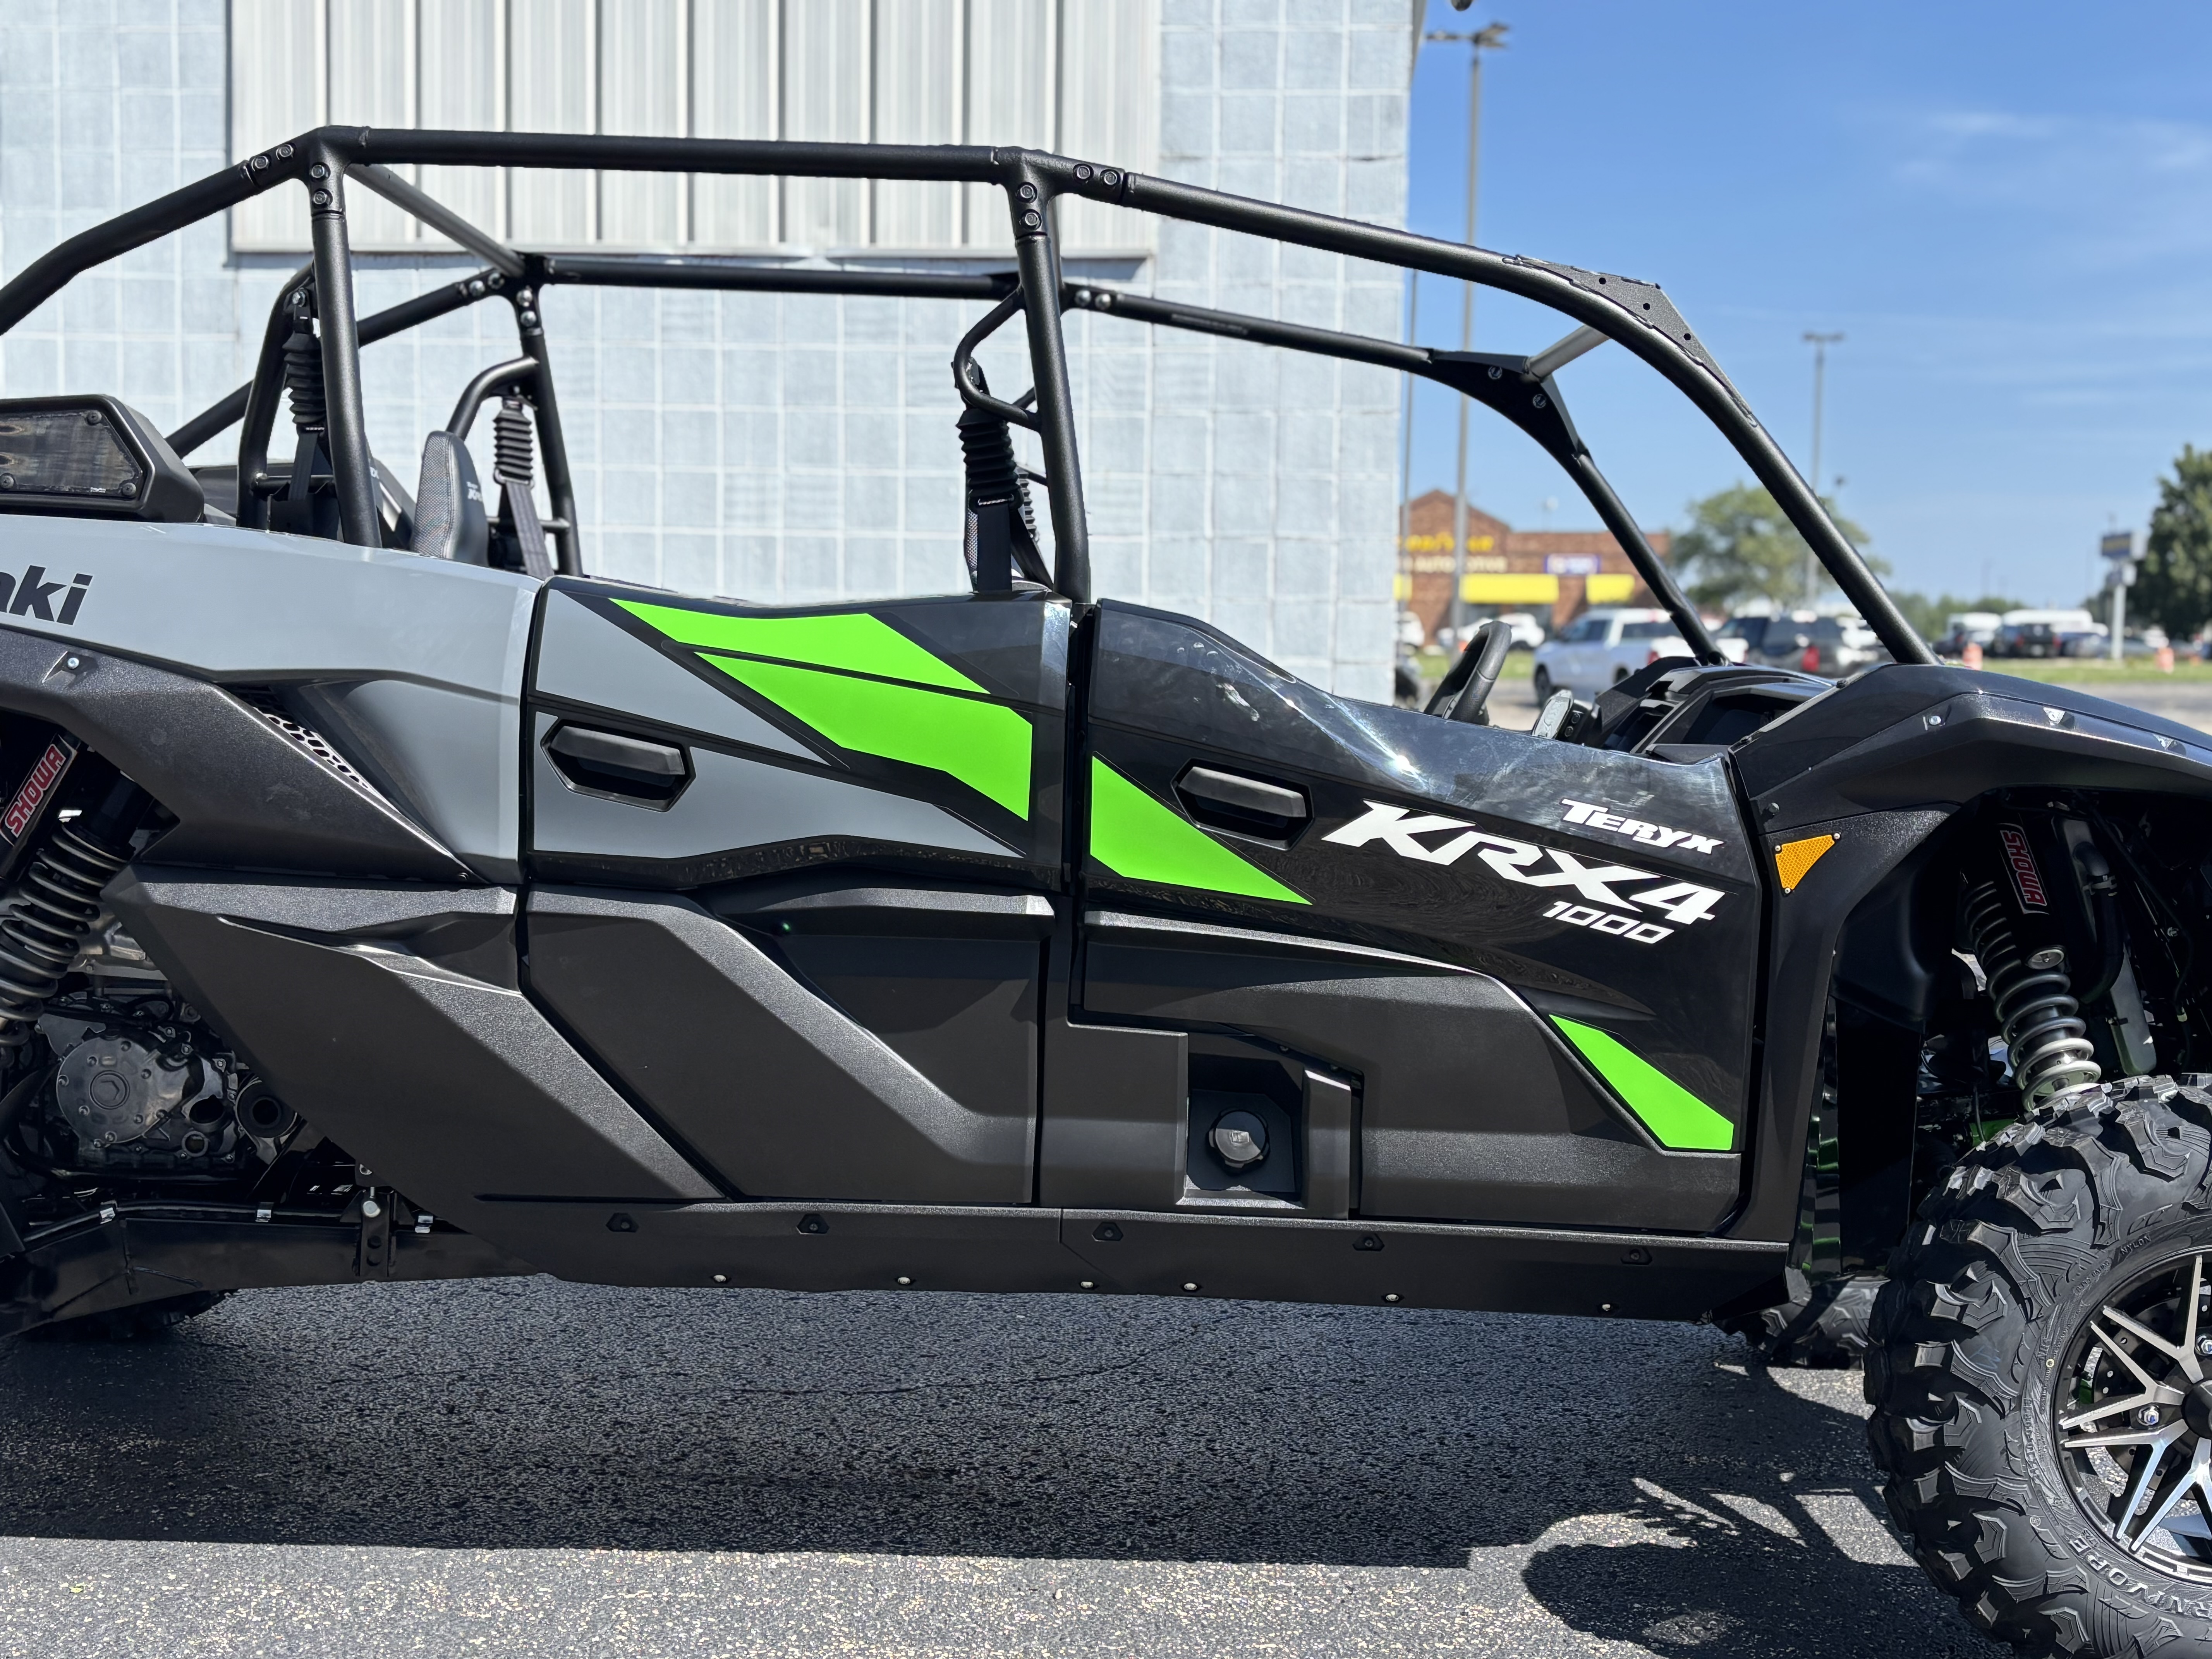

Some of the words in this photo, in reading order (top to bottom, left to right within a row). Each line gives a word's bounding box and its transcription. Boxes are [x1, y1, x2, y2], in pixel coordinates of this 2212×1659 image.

[5, 744, 66, 838] SHOWA
[1561, 799, 1723, 854] TERYX
[1321, 800, 1725, 925] KRX4
[2000, 830, 2047, 906] SHOWA
[1543, 901, 1674, 944] 1000
[2120, 1235, 2152, 1255] NYLON
